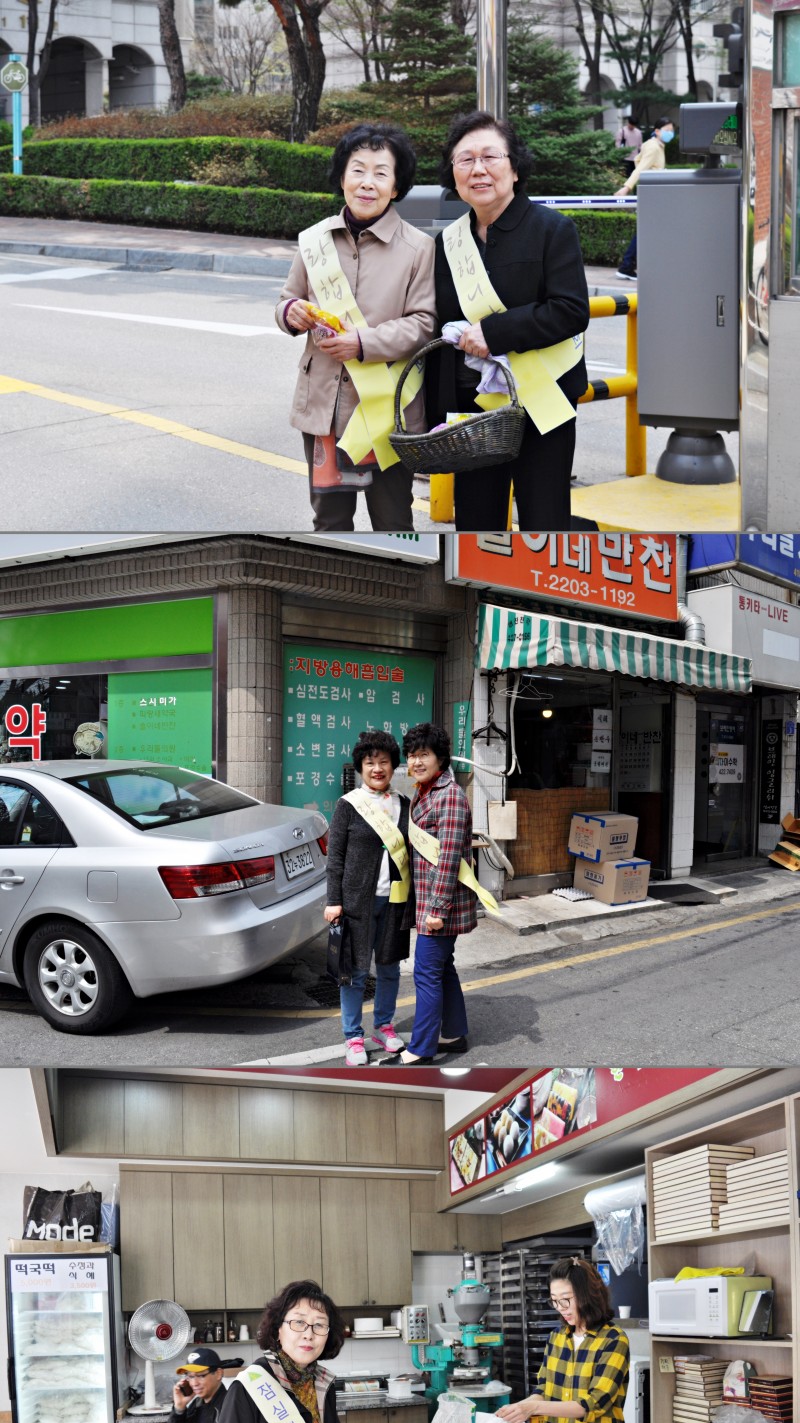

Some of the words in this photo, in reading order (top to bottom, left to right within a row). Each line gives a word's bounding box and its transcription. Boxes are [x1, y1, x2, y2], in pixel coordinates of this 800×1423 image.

[530, 569, 636, 607] T.2203-1192
[140, 697, 177, 706] 스시미가
[296, 684, 351, 702] 심전도검사
[5, 704, 46, 760] 약
[26, 1217, 95, 1242] Mode
[15, 1263, 56, 1276] 떡국떡
[69, 1261, 94, 1270] 수정과
